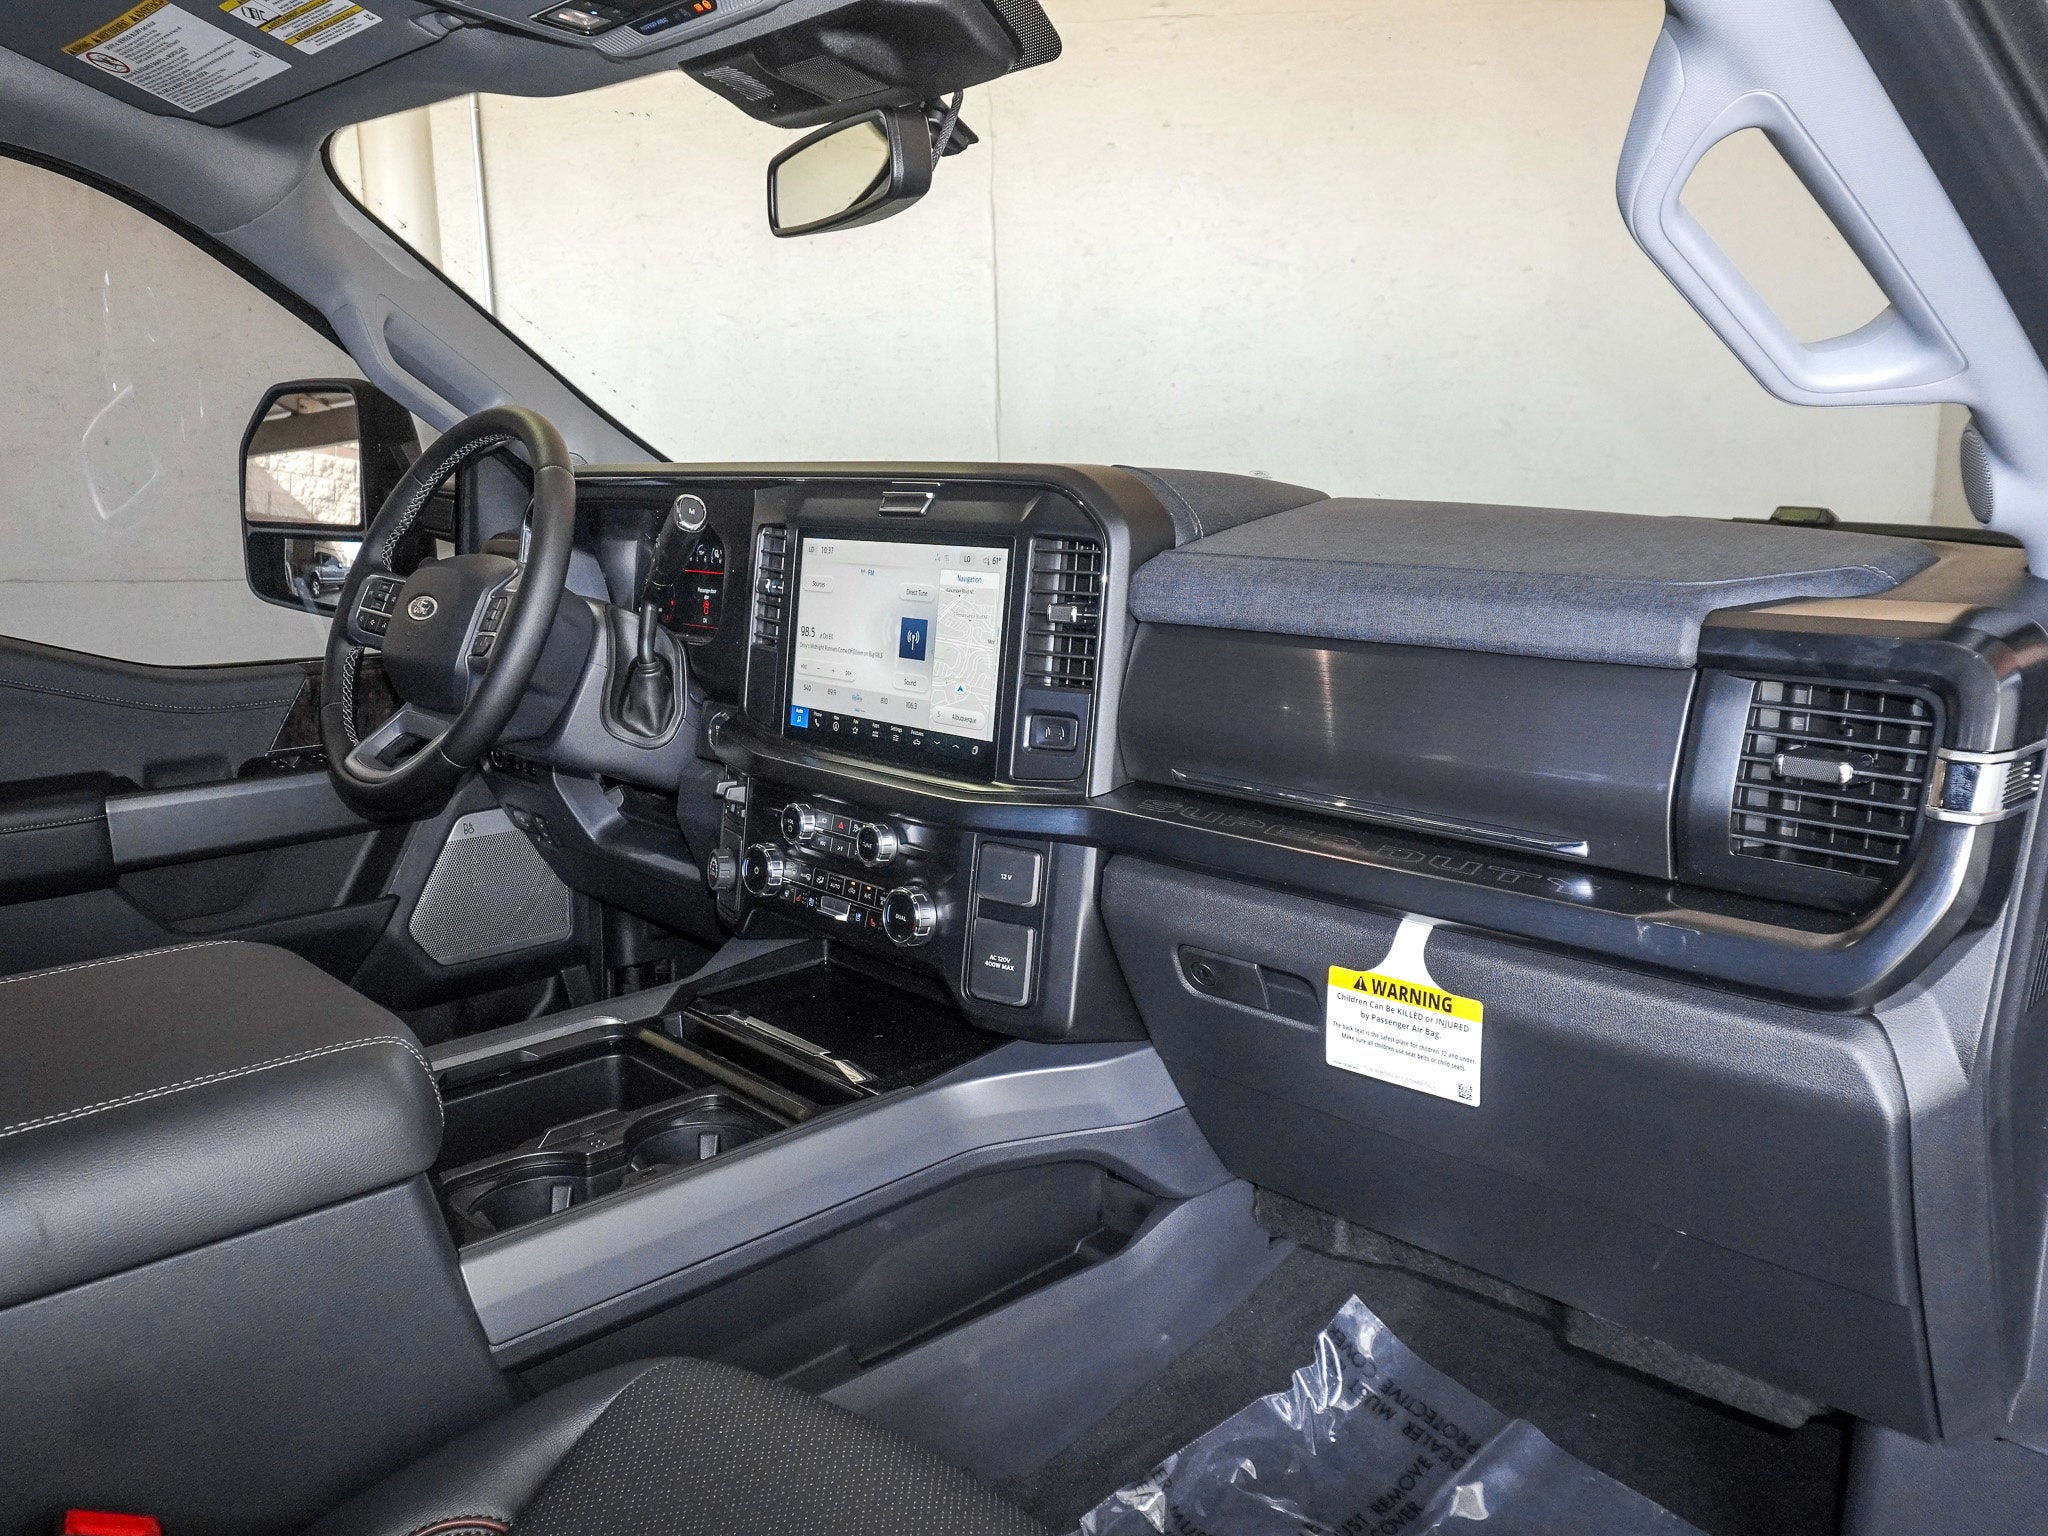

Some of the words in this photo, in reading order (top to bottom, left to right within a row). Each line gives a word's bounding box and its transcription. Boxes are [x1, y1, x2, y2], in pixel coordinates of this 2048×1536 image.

[957, 575, 982, 584] Navigation
[800, 625, 816, 637] 98.5
[952, 714, 977, 724] Albuquerque
[1375, 844, 1602, 900] DUTY
[895, 913, 906, 922] DUAL
[985, 960, 1000, 968] 400W
[1371, 978, 1453, 1013] WARNING
[1337, 992, 1367, 1006] Children
[1370, 1001, 1383, 1010] Can
[1386, 1005, 1395, 1013] Be
[1397, 1008, 1423, 1020] KILLED
[1436, 1018, 1469, 1032] INJURED
[1361, 1011, 1370, 1021] by
[1372, 1014, 1410, 1030] Passenger
[1412, 1025, 1423, 1033] Air
[1425, 1028, 1441, 1040] Bag.
[1342, 1032, 1354, 1040] Make
[1375, 1042, 1394, 1051] children
[1418, 1053, 1429, 1061] belts
[1438, 1060, 1450, 1068] child
[1419, 1045, 1439, 1054] children
[1379, 1379, 1482, 1455] PROTECTIVE
[1402, 1421, 1466, 1470] DEALER
[1370, 1454, 1433, 1516] REMOVE
